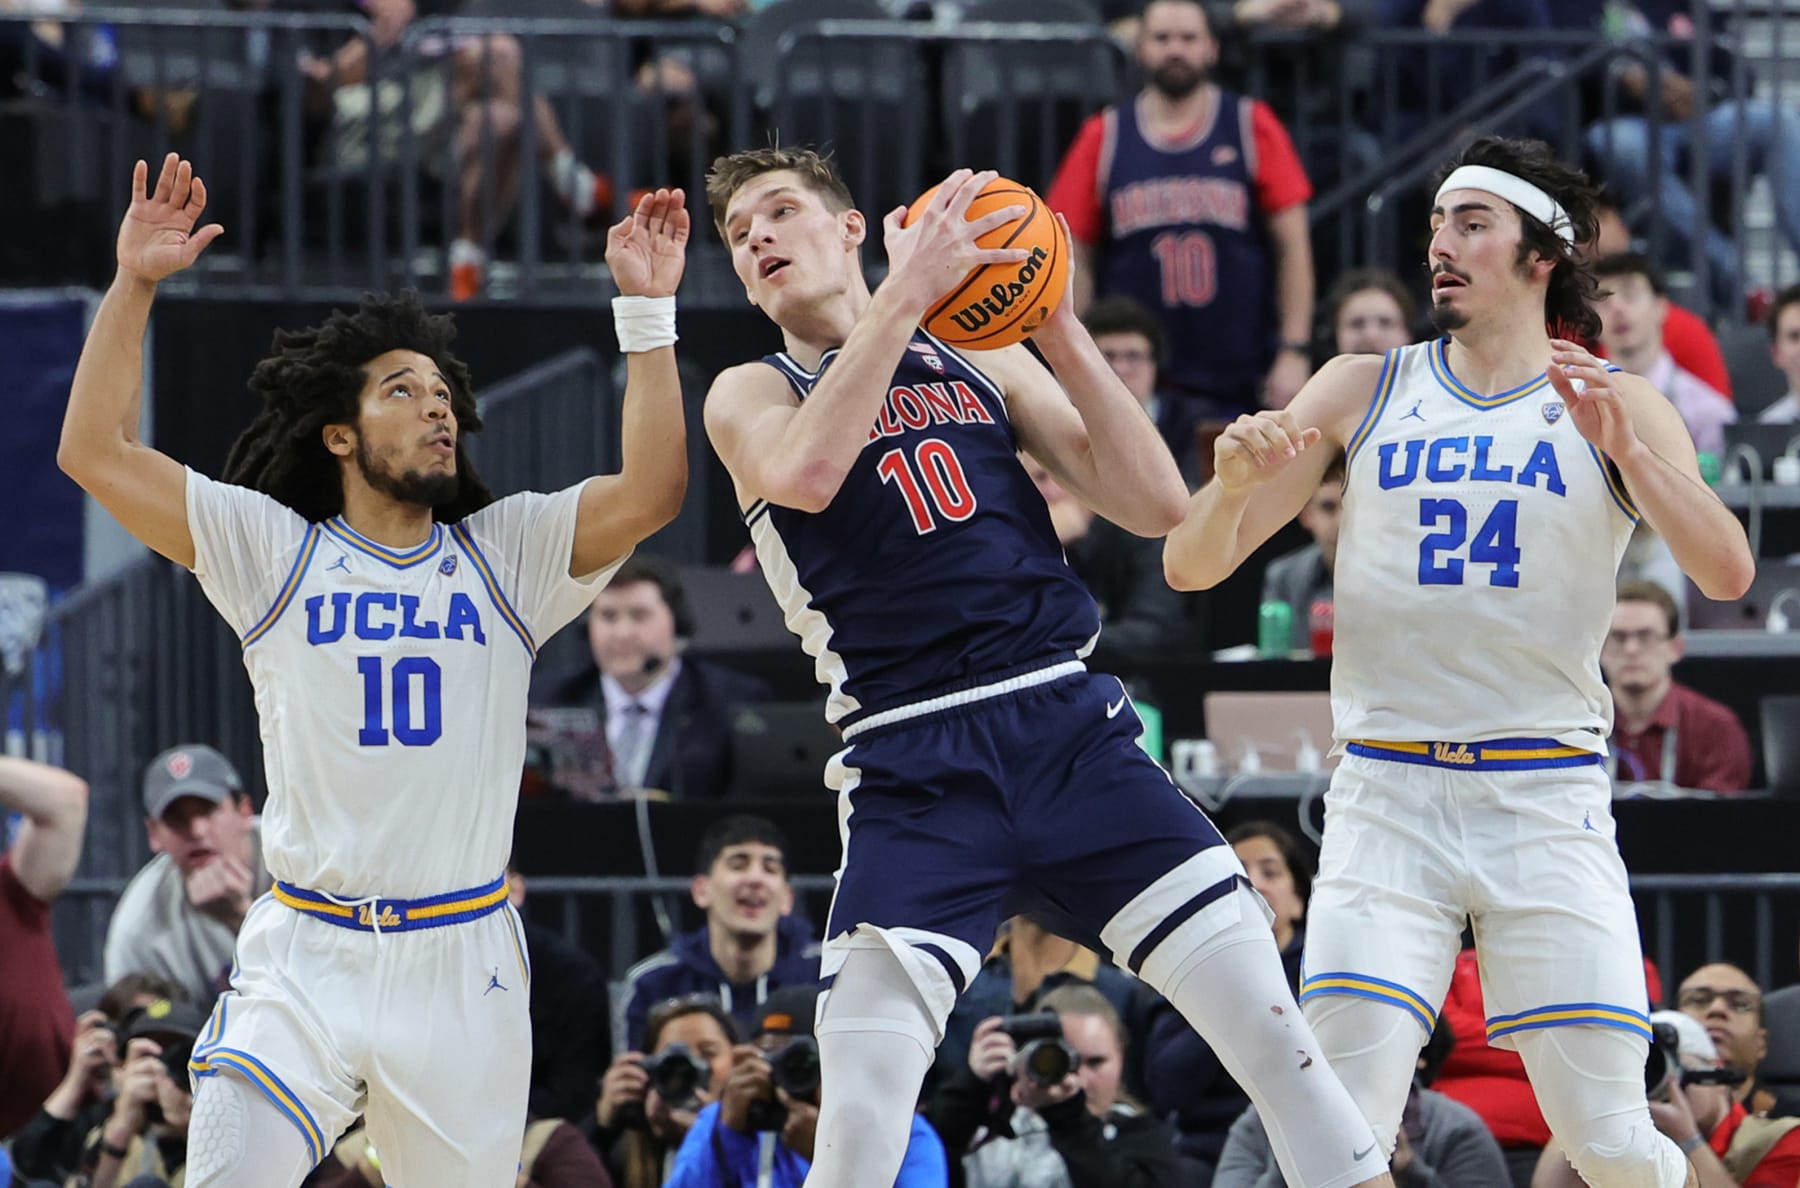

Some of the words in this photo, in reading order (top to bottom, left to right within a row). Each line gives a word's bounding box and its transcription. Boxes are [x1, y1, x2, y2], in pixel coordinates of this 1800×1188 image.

[949, 246, 1049, 332] Wilson
[1152, 231, 1217, 308] 10
[876, 438, 977, 535] 10
[1378, 435, 1567, 497] UCLA
[1418, 498, 1521, 588] 24
[305, 592, 486, 646] UCLA
[357, 656, 442, 746] 10
[1433, 742, 1476, 764] Ucla
